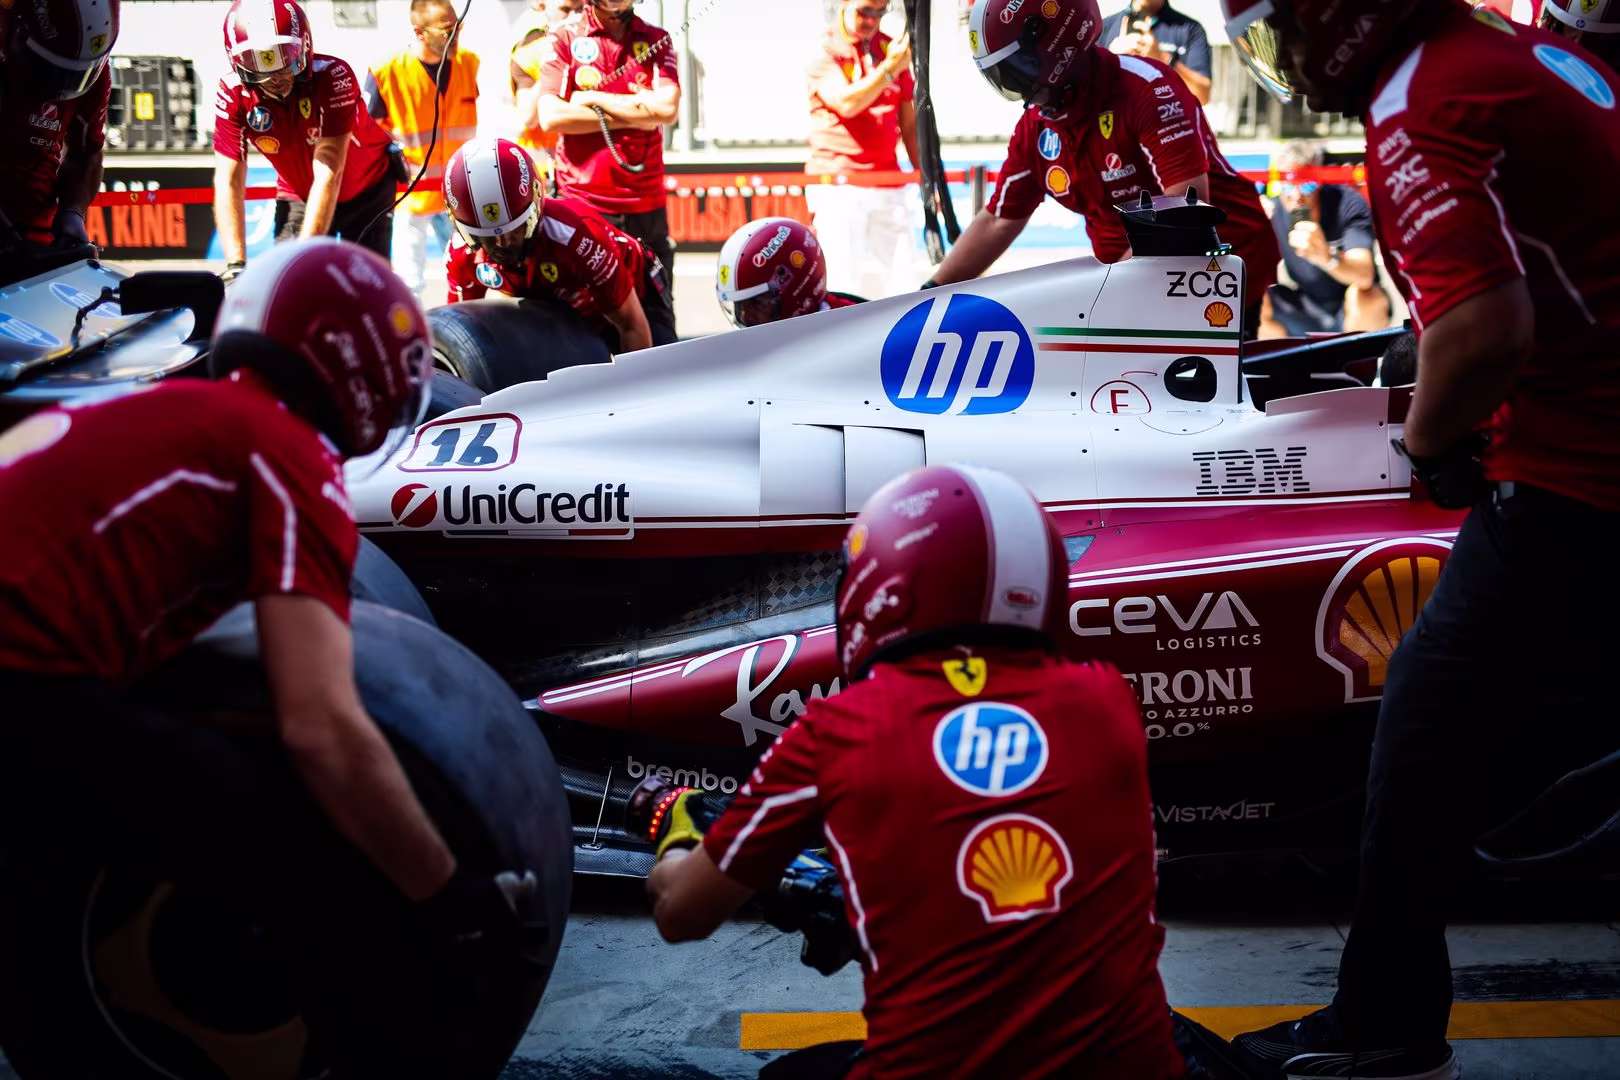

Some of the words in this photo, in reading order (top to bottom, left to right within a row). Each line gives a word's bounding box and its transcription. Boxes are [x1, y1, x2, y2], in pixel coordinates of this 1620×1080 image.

[111, 202, 187, 248] KING
[897, 293, 1021, 415] hp
[1110, 390, 1129, 414] F
[425, 422, 499, 466] 16
[1192, 446, 1310, 495] IBM
[443, 483, 630, 525] UniCredit
[1156, 633, 1262, 650] LOGISTICS
[1164, 704, 1254, 719] AZZURRO
[954, 703, 1030, 792] hp
[627, 755, 738, 794] brembo
